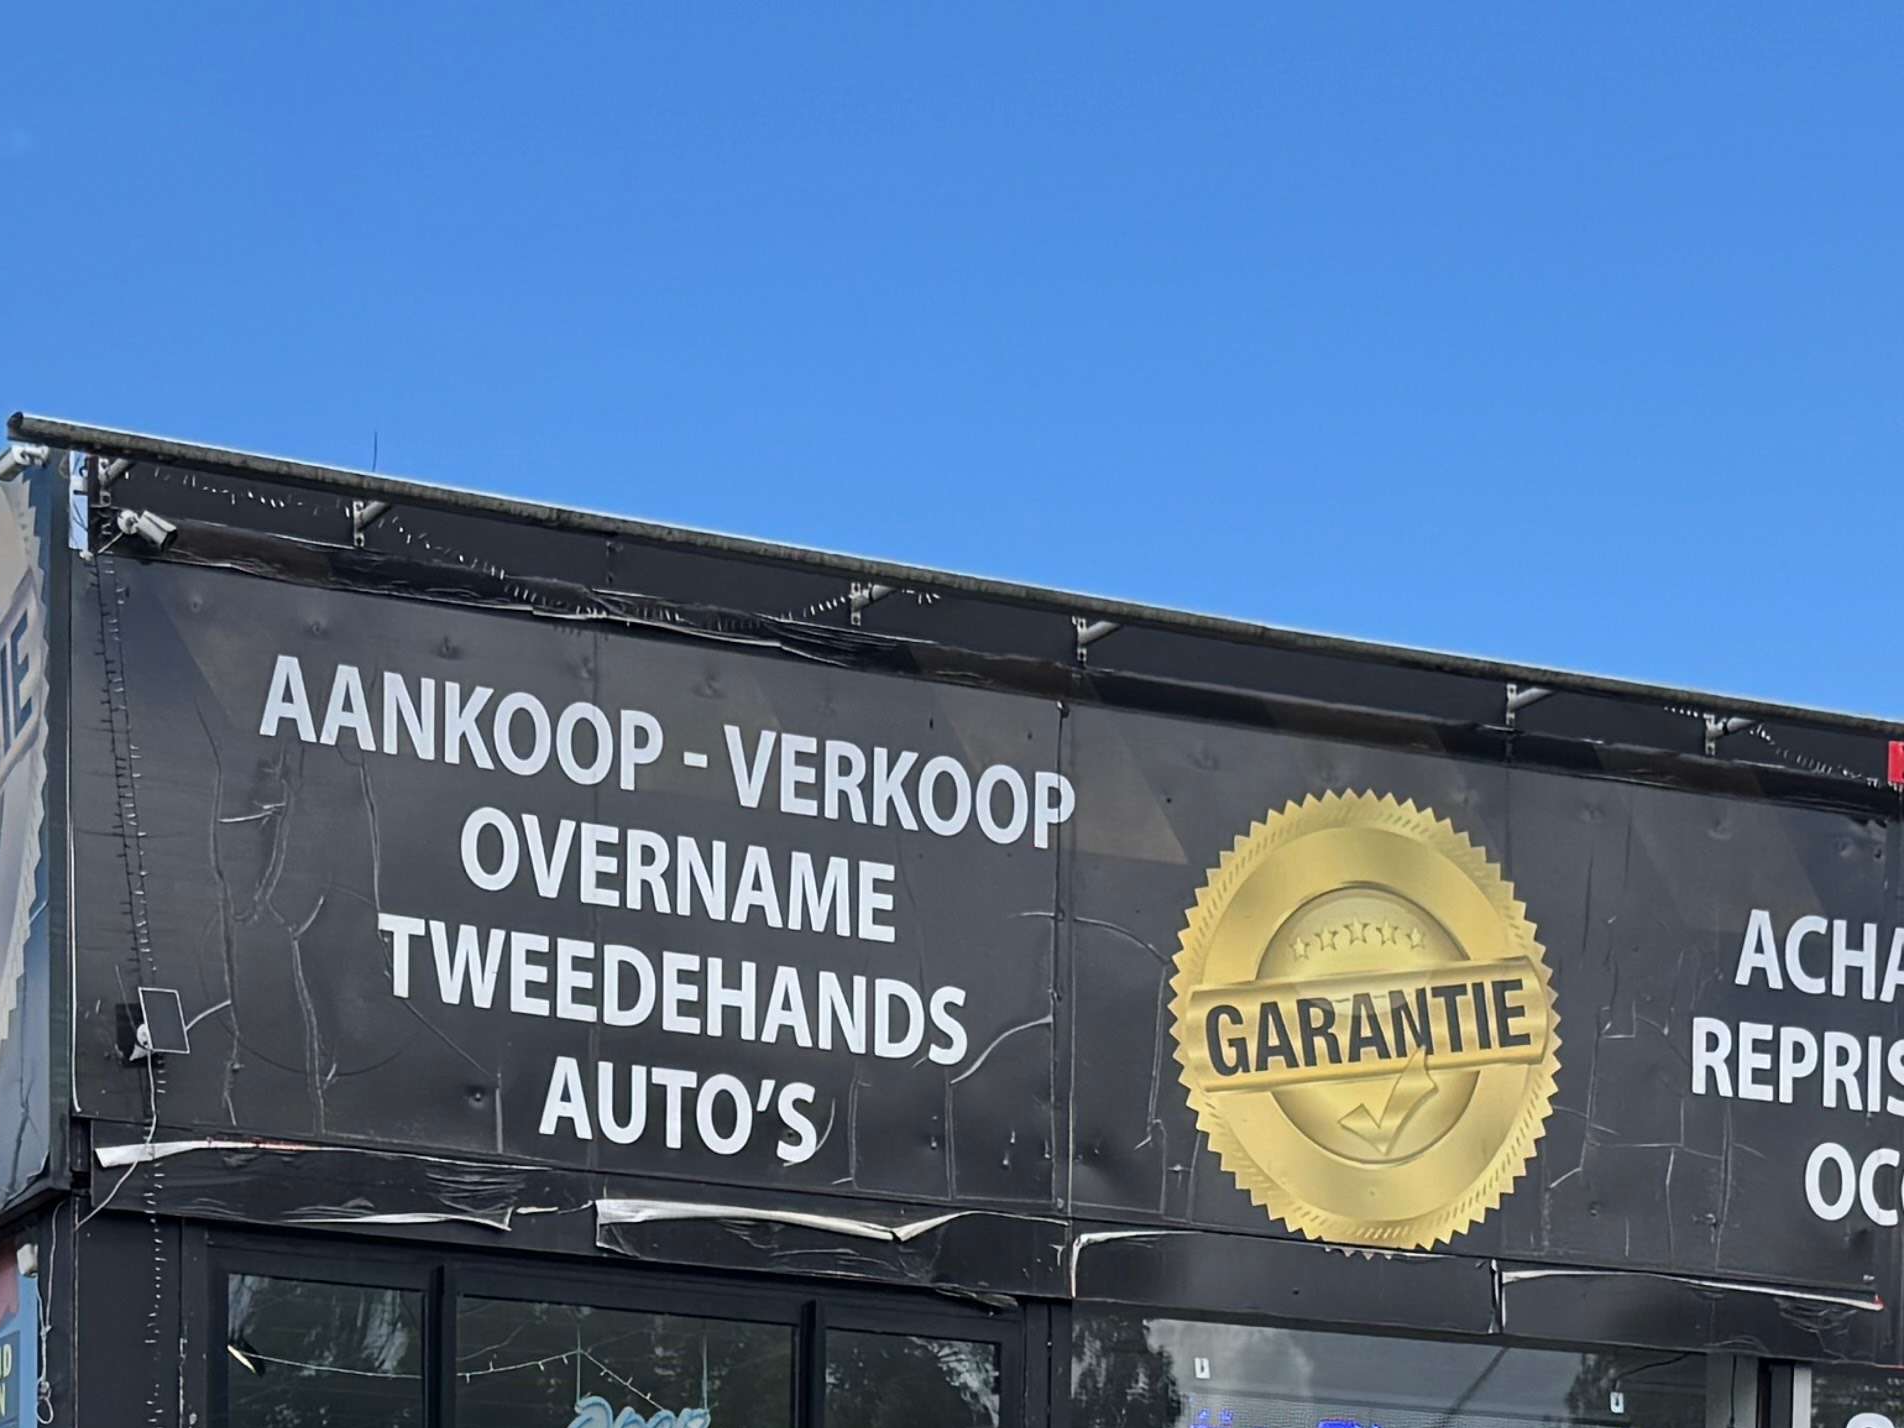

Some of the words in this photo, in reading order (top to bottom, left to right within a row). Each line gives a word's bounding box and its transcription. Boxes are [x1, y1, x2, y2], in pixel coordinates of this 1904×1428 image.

[259, 655, 664, 791] AANKOOP
[723, 725, 1076, 848] VERKOOP
[461, 807, 896, 942] OVERNAME
[378, 913, 967, 1064] TWEEDEHANDS
[1205, 978, 1532, 1077] GARANTIE
[539, 1056, 818, 1163] AUTO'S
